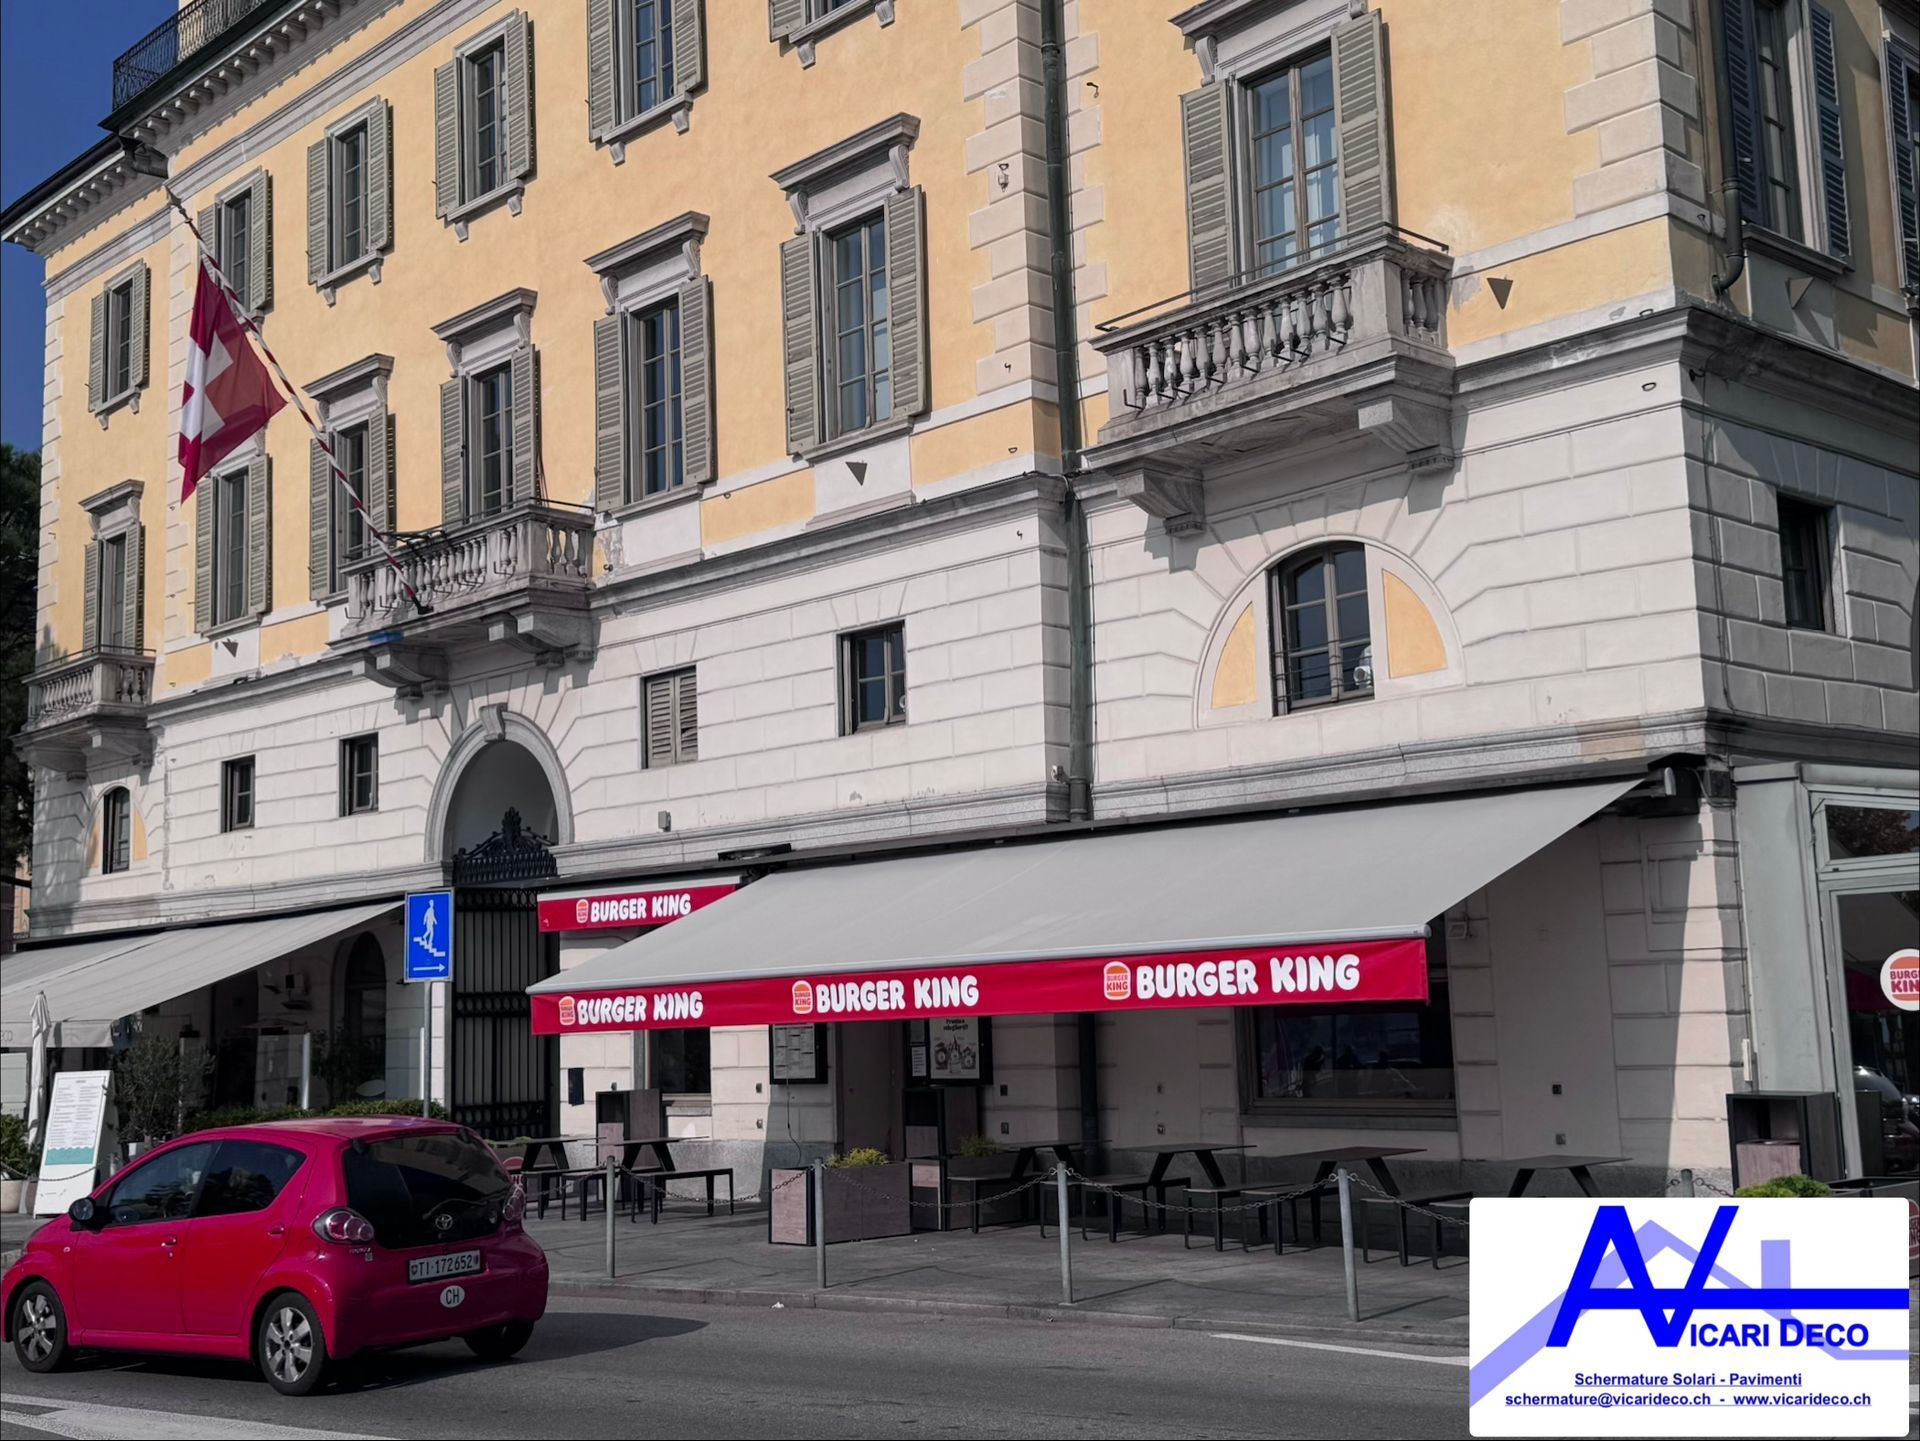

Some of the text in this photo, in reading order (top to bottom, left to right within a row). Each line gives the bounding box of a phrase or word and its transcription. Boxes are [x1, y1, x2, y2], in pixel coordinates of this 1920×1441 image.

[590, 898, 647, 923] BURGER
[652, 894, 691, 917] KING
[1106, 981, 1128, 991] KING
[1136, 954, 1360, 1000] BURGER KING
[1890, 970, 1919, 980] BURG
[577, 991, 704, 1025] BURGER KING
[816, 975, 980, 1014] BURGER KING
[445, 1288, 460, 1305] CH
